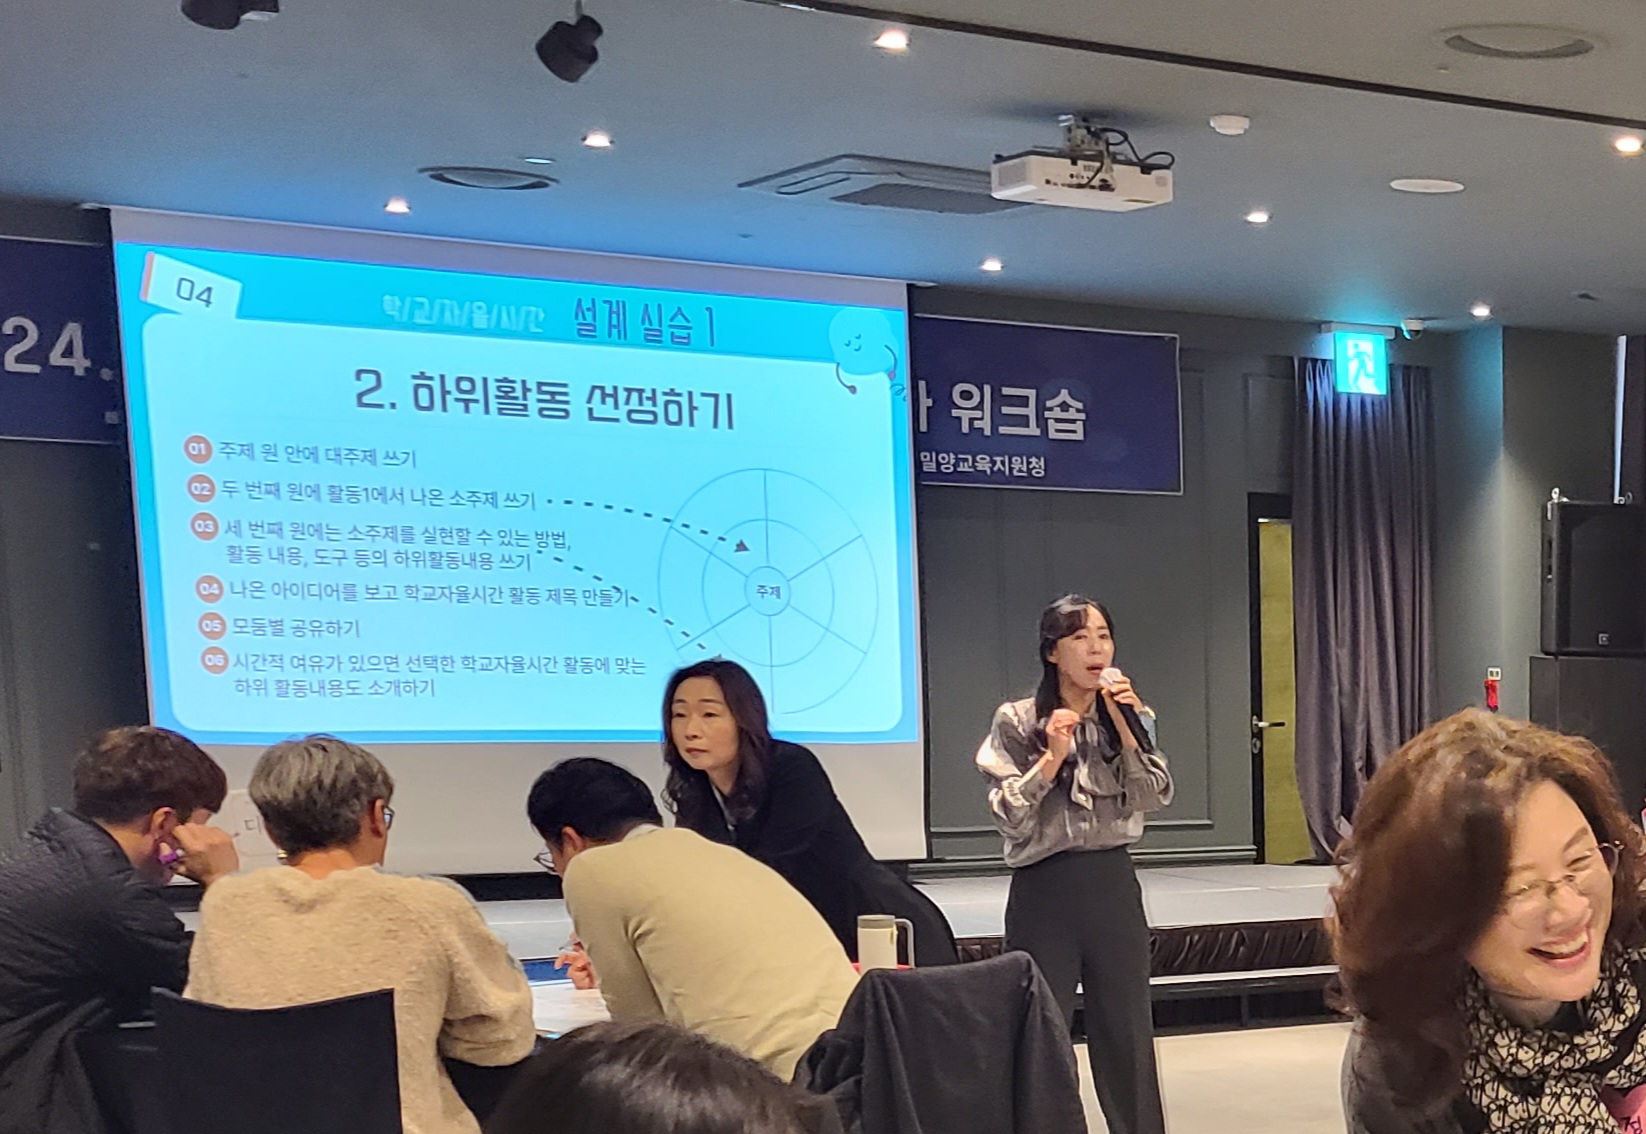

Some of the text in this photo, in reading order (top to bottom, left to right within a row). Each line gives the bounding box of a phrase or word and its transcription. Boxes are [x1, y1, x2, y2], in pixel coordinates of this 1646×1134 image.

[176, 277, 214, 308] 04
[574, 297, 628, 342] 설계
[641, 302, 693, 347] 실습
[704, 306, 715, 348] 1
[354, 368, 734, 431] 2. 하위활동 선정하기
[951, 382, 1086, 441] 워크숍
[219, 441, 255, 461] 주제
[261, 443, 279, 462] 원
[285, 445, 319, 464] 안에
[325, 447, 377, 466] 대주제
[382, 450, 417, 468] 쓰기
[920, 451, 1045, 477] 밀양교육지원청
[221, 480, 239, 498] 두
[245, 482, 281, 500] 번째
[286, 483, 321, 502] 원에
[327, 484, 404, 505] 활동1에서
[411, 488, 444, 507] 나온
[450, 490, 498, 509] 소주제
[503, 492, 535, 511] 쓰기
[225, 519, 241, 539] 세
[248, 521, 283, 540] 번째
[289, 522, 342, 542] 원에는
[347, 524, 416, 544] 소주제를
[421, 526, 471, 546] 실현할
[477, 529, 493, 546] 수
[498, 529, 530, 548] 있는
[535, 531, 570, 552] 방법,
[226, 545, 530, 572] 활동 내용, 도구 등의 하위활동내용 쓰기
[229, 580, 266, 599] 나온
[271, 581, 359, 602] 아이디어를
[364, 584, 399, 601] 보고
[404, 584, 504, 604] 학교자율시간
[509, 586, 541, 605] 활동
[546, 588, 578, 606] 제목
[582, 589, 629, 608] 만들기
[756, 584, 781, 599] 주제
[232, 618, 285, 637] 모둠별
[290, 619, 360, 638] 공유하기
[233, 653, 285, 673] 시간적
[290, 654, 343, 673] 여유가
[349, 654, 400, 674] 있으면
[405, 655, 455, 674] 선택한
[460, 655, 558, 674] 학교자율시간
[563, 656, 610, 675] 활동에
[615, 657, 646, 676] 맞는
[233, 678, 435, 699] 하위 활동내용도 소개하기
